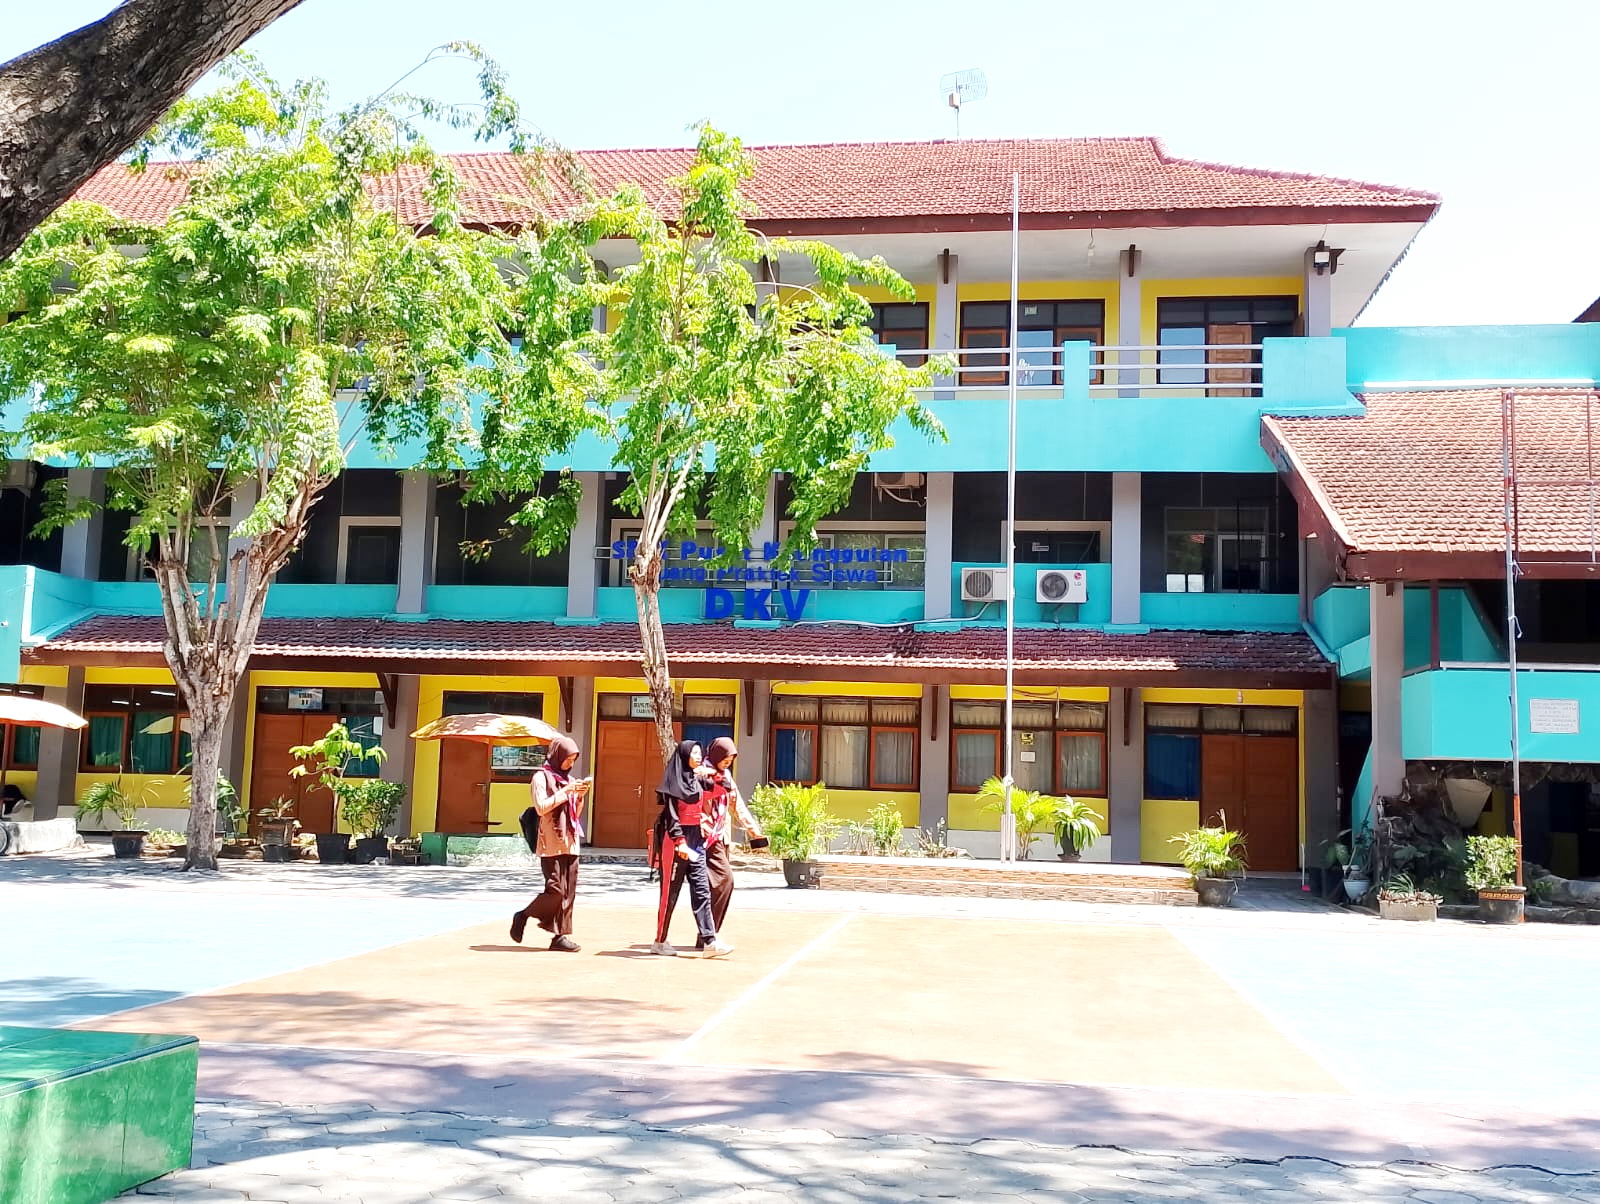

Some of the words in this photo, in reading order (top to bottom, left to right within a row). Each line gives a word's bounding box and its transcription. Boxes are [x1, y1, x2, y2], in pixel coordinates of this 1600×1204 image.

[681, 541, 751, 560] Pust
[763, 541, 907, 563] Kunggulan
[660, 567, 705, 583] uang
[812, 563, 877, 582] Siswa
[705, 588, 810, 620] DKV
